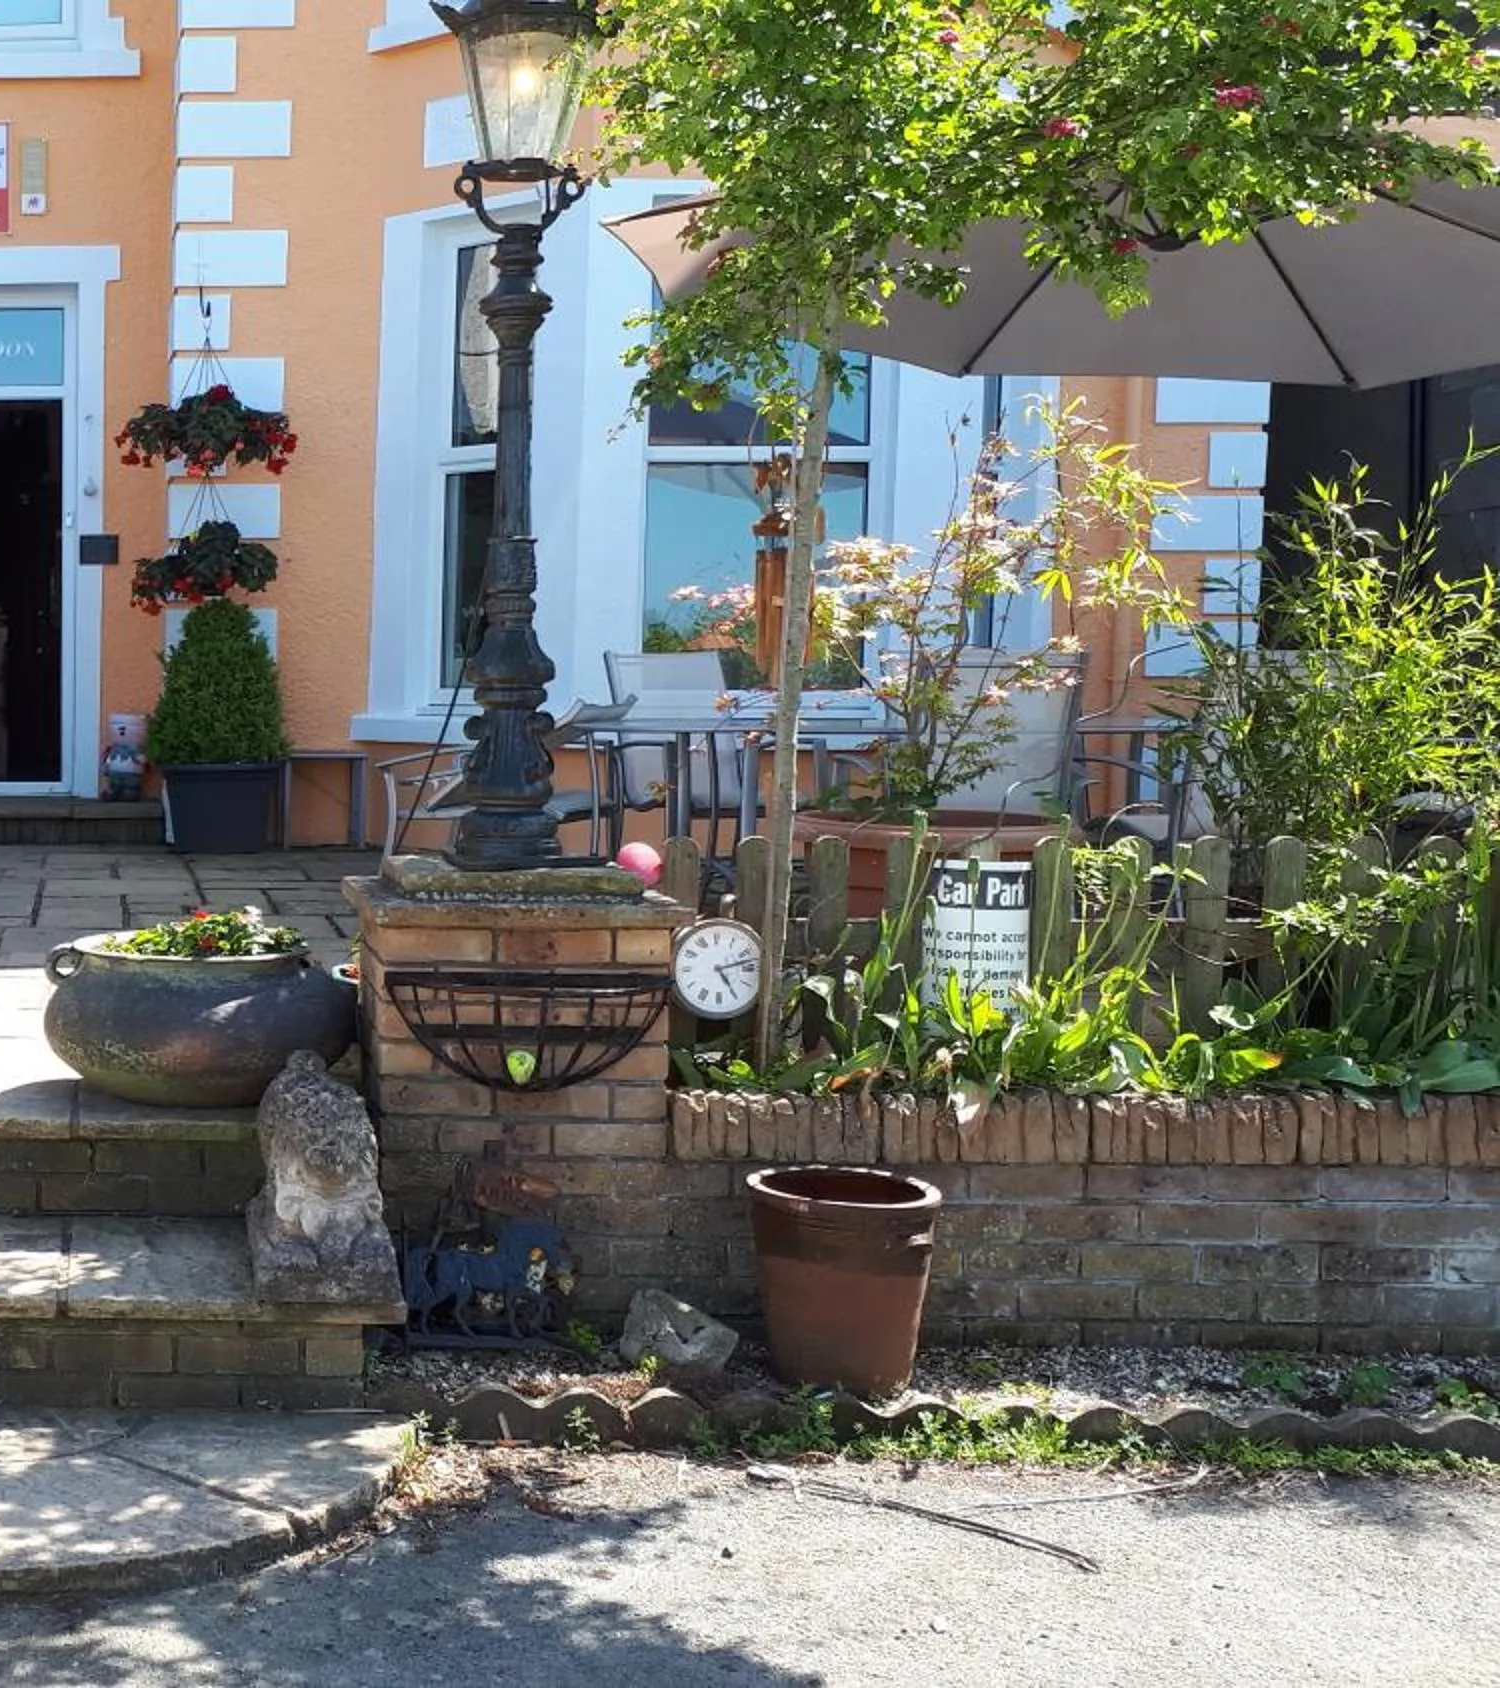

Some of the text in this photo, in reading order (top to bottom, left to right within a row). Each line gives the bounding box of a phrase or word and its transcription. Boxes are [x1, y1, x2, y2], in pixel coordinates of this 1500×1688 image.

[937, 874, 1025, 907] Car Park
[946, 931, 997, 943] cannot
[925, 946, 1015, 963] responsibility
